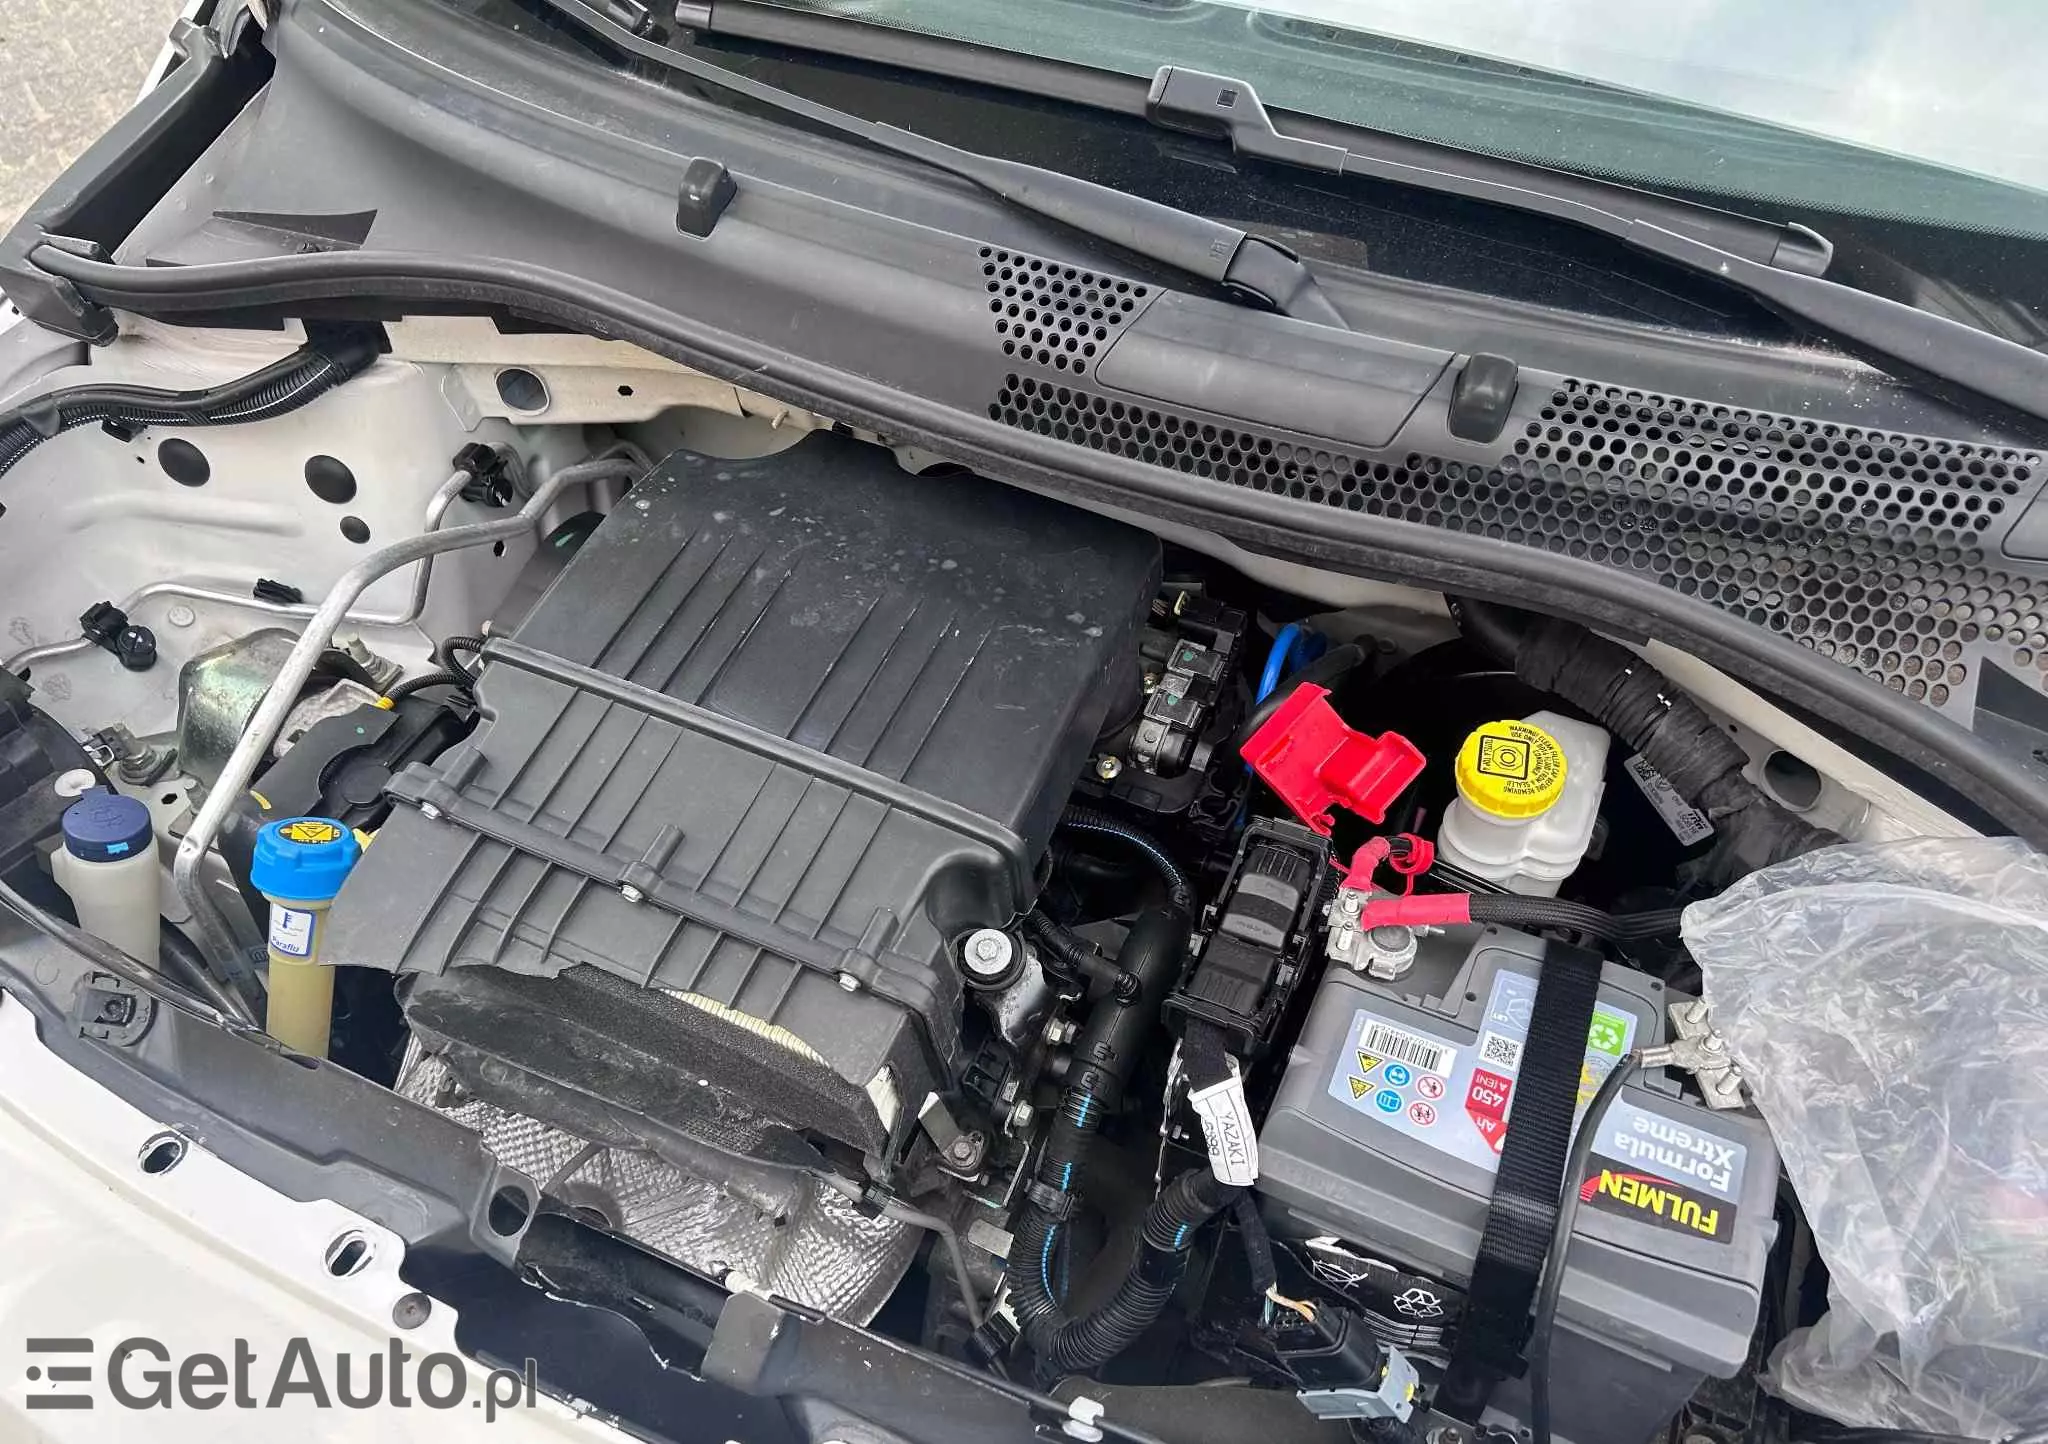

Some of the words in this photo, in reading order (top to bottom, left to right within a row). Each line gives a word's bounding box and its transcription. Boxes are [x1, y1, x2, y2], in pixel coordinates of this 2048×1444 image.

[1472, 1086, 1504, 1108] 450
[1220, 1112, 1245, 1165] YAZAKI
[1477, 1117, 1496, 1133] Ah
[1632, 1116, 1736, 1170] Xtreme
[1614, 1131, 1731, 1192] Formula
[1598, 1168, 1719, 1235] FULMEN
